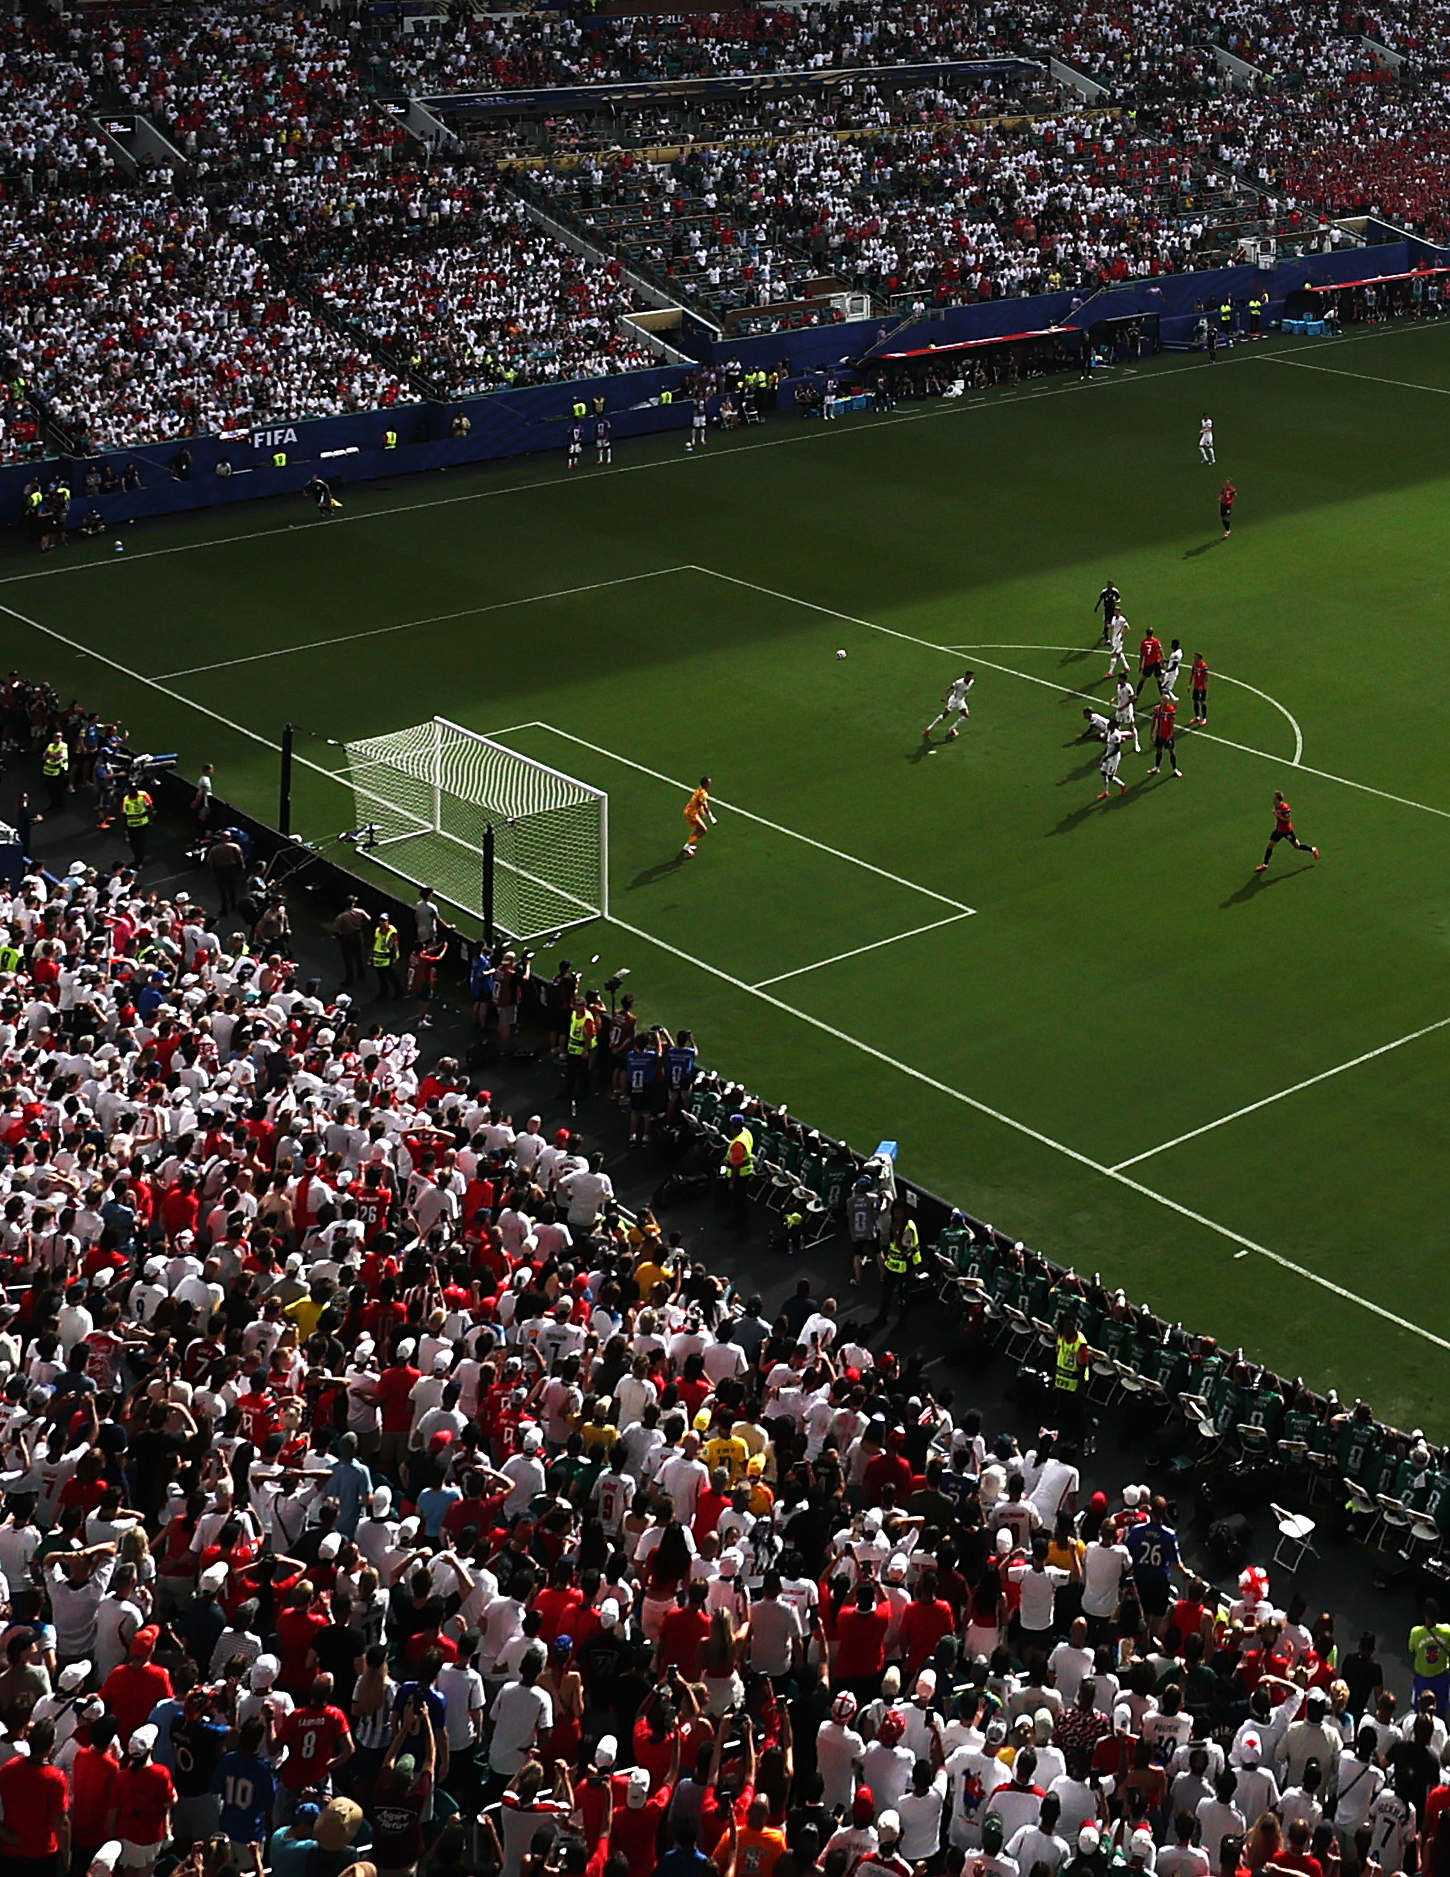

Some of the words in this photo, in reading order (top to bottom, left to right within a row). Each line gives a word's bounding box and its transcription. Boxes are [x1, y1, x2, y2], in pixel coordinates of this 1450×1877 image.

[255, 428, 297, 448] FIFA
[139, 1115, 149, 1136] 7
[408, 1185, 417, 1205] 8
[359, 1206, 377, 1224] 26
[136, 1299, 145, 1320] 9
[549, 1342, 561, 1359] 7
[192, 1356, 209, 1380] 7
[43, 1480, 55, 1501] 7
[1139, 1541, 1161, 1565] 26
[302, 1731, 316, 1758] 8
[226, 1776, 253, 1809] 10
[1381, 1817, 1396, 1848] 7
